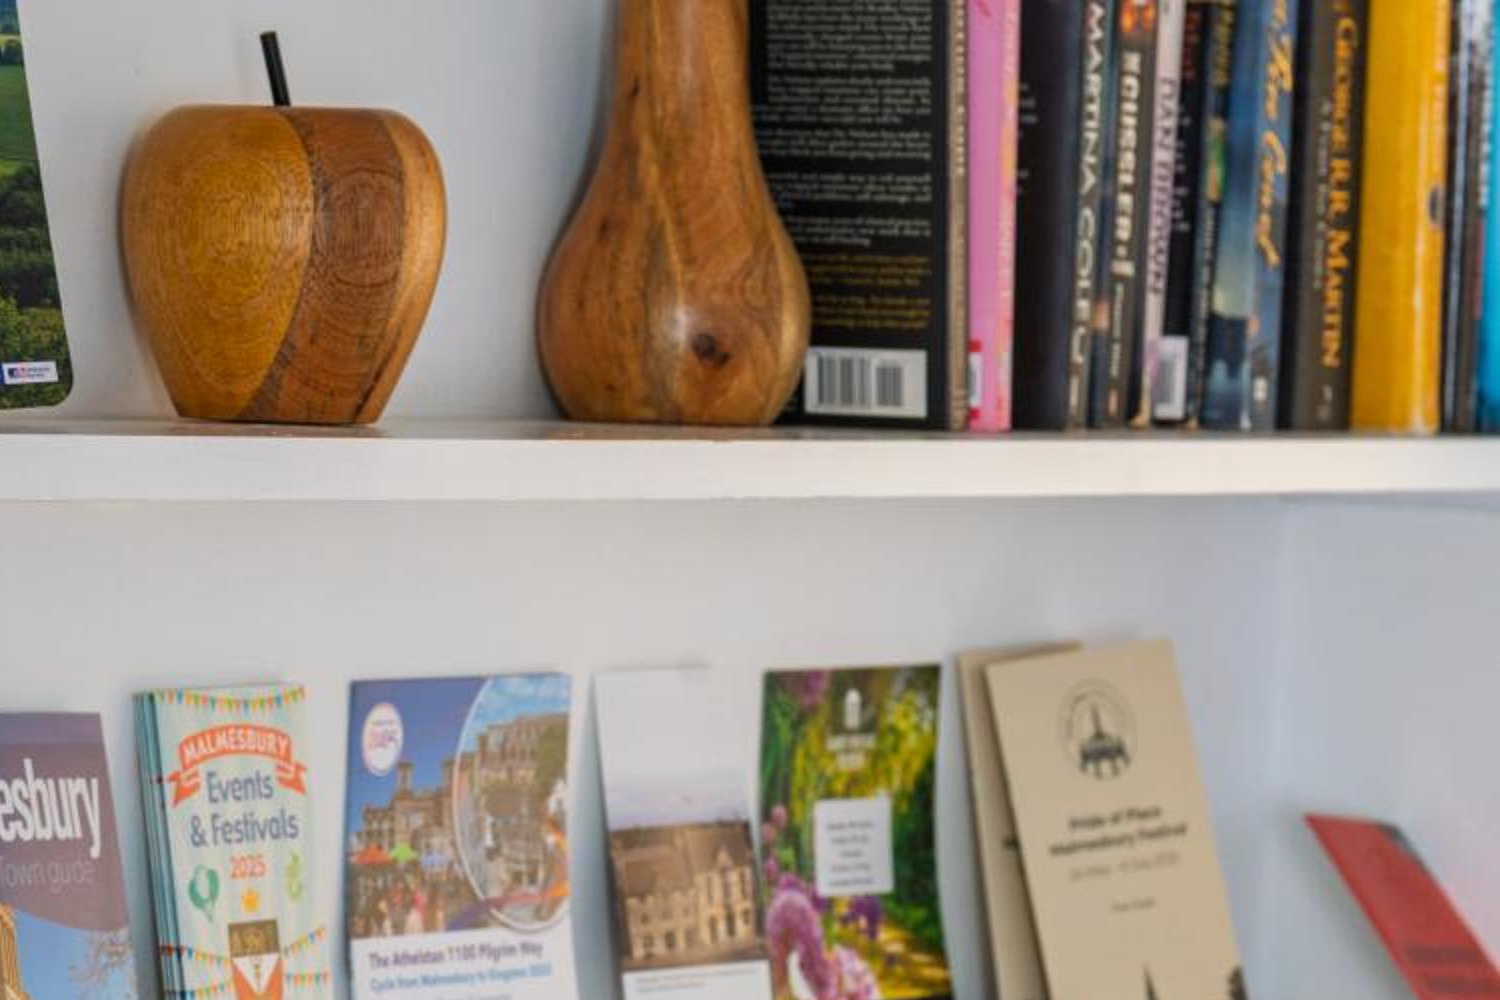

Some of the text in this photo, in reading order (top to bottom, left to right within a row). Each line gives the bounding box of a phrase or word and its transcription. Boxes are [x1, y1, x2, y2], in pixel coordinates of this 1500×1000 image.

[1074, 3, 1106, 318] MARTINA COLE
[1322, 230, 1350, 369] MARTIN
[182, 729, 290, 760] MALMESBURY
[206, 770, 274, 804] Events
[189, 808, 300, 848] & Festivals
[229, 853, 269, 879] 2025
